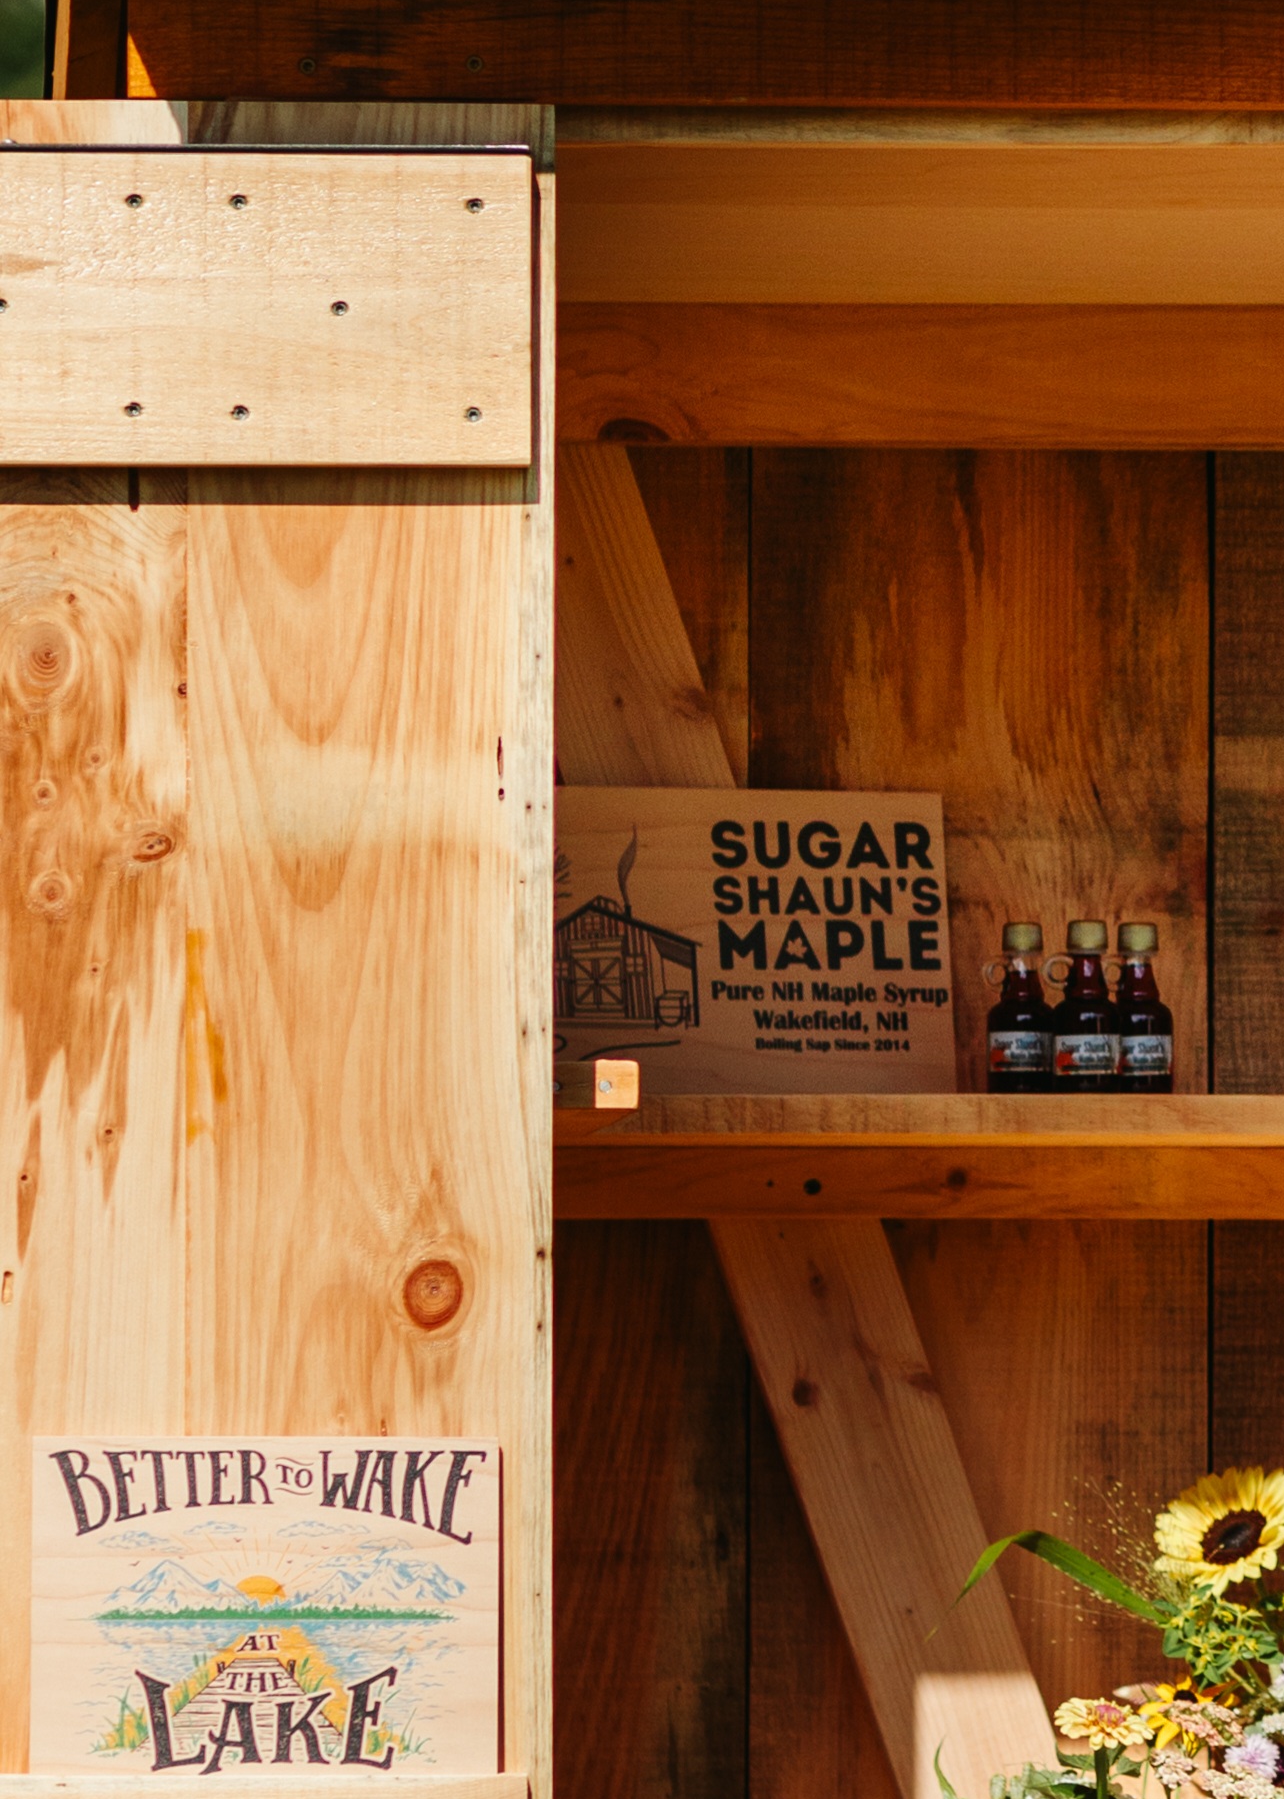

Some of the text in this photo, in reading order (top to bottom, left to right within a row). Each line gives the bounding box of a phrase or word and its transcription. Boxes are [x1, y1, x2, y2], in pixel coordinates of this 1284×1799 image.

[711, 820, 934, 869] SUGAR
[713, 875, 941, 915] SHAUN'S
[718, 919, 942, 971] MAPLE
[711, 980, 949, 1007] Pure NH Maple Syrup
[753, 1009, 909, 1033] Wakefield, NH
[755, 1037, 910, 1052] Boiling Sap Since 2014
[49, 1449, 487, 1545] BETTER TO WAKE
[236, 1633, 280, 1652] AT
[225, 1672, 288, 1691] THE
[134, 1666, 399, 1775] LAKE
